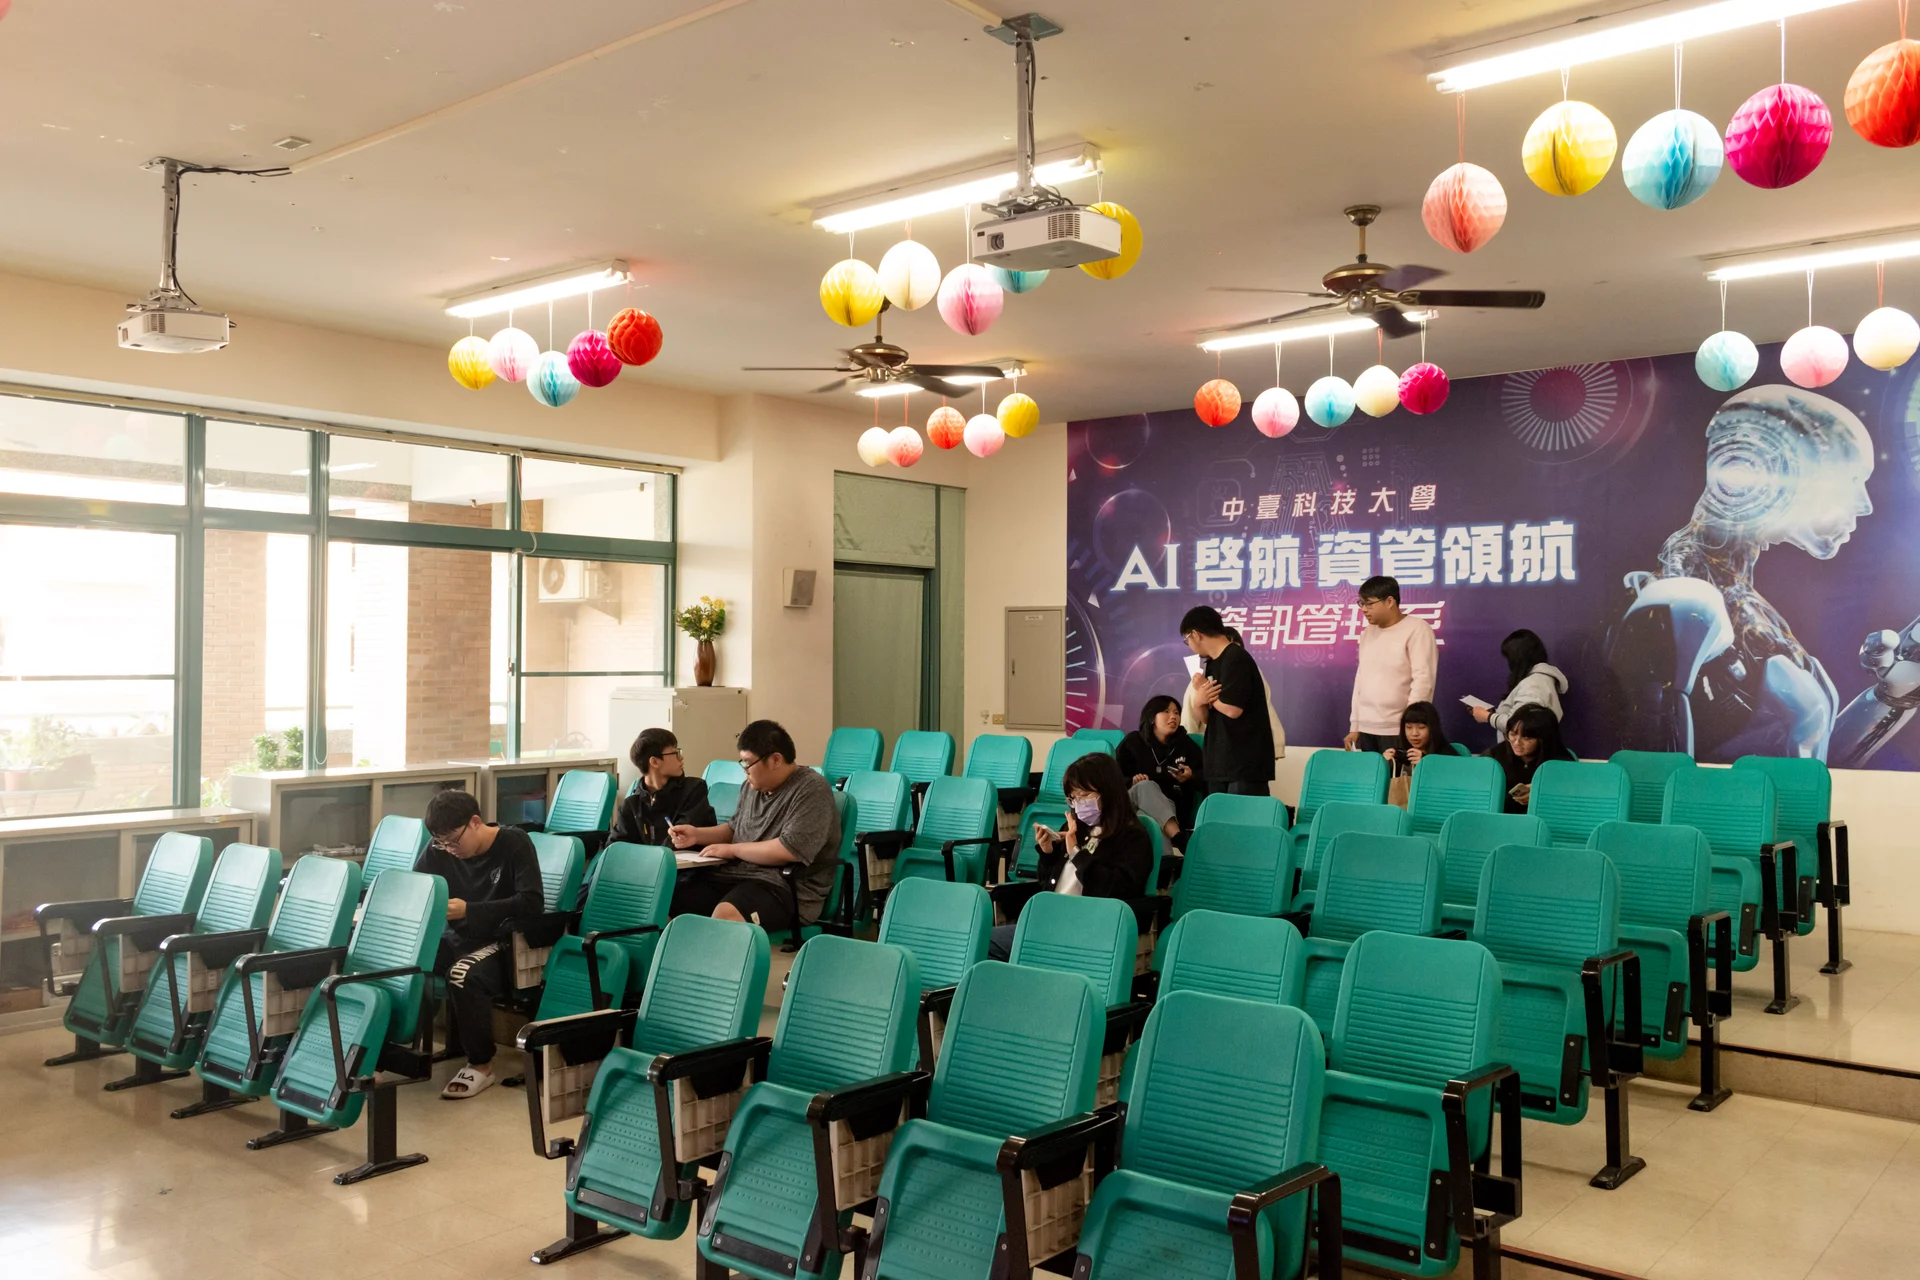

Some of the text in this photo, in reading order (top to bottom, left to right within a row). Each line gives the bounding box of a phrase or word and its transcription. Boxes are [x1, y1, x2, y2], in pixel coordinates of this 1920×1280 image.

[1221, 484, 1437, 522] 中臺科技大學
[1110, 543, 1181, 591] AI
[1318, 520, 1576, 587] 資管領航
[450, 958, 476, 988] LADY
